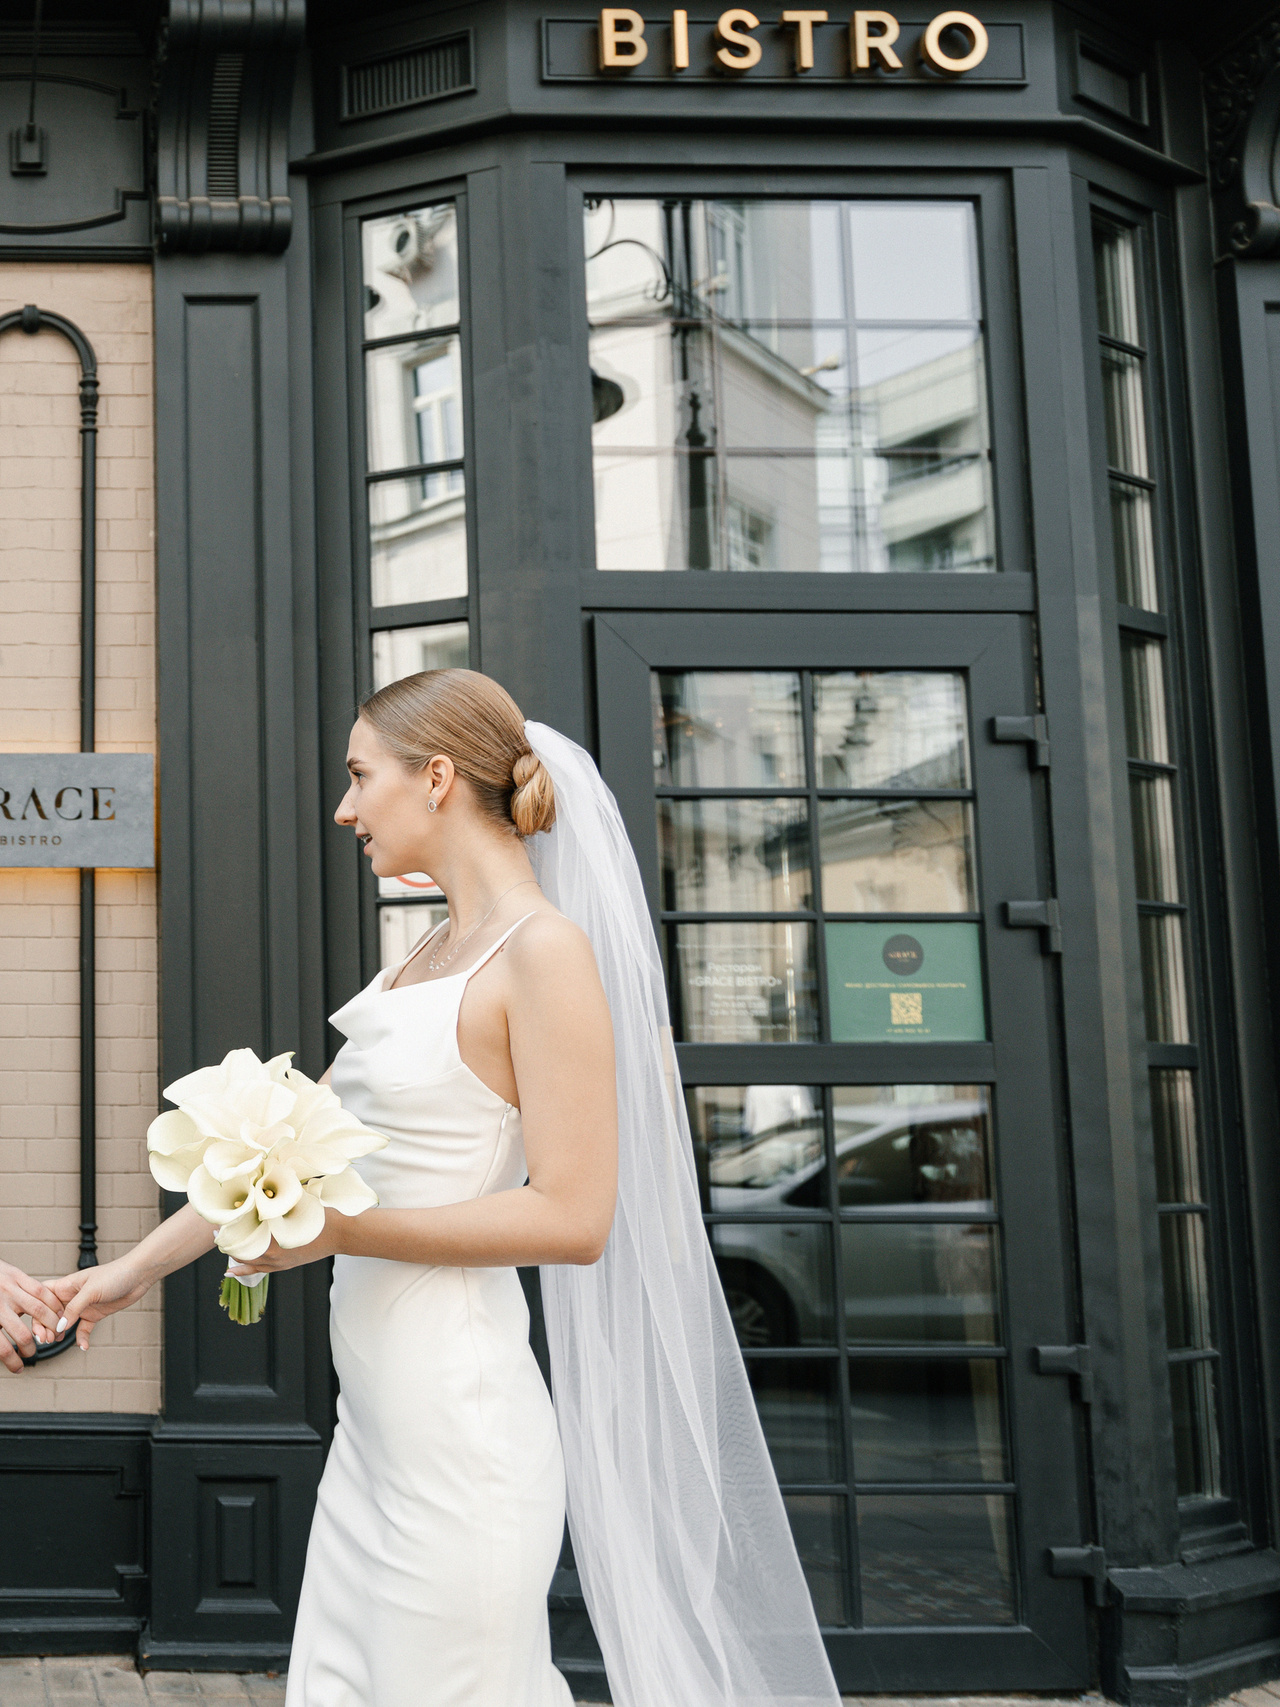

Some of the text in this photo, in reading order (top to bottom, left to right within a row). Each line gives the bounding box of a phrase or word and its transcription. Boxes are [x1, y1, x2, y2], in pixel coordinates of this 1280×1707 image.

[599, 8, 988, 74] BISTRO
[0, 835, 63, 846] BISTRO
[706, 962, 762, 974] Ресторан
[688, 976, 782, 987] «GRACE BISTRO»
